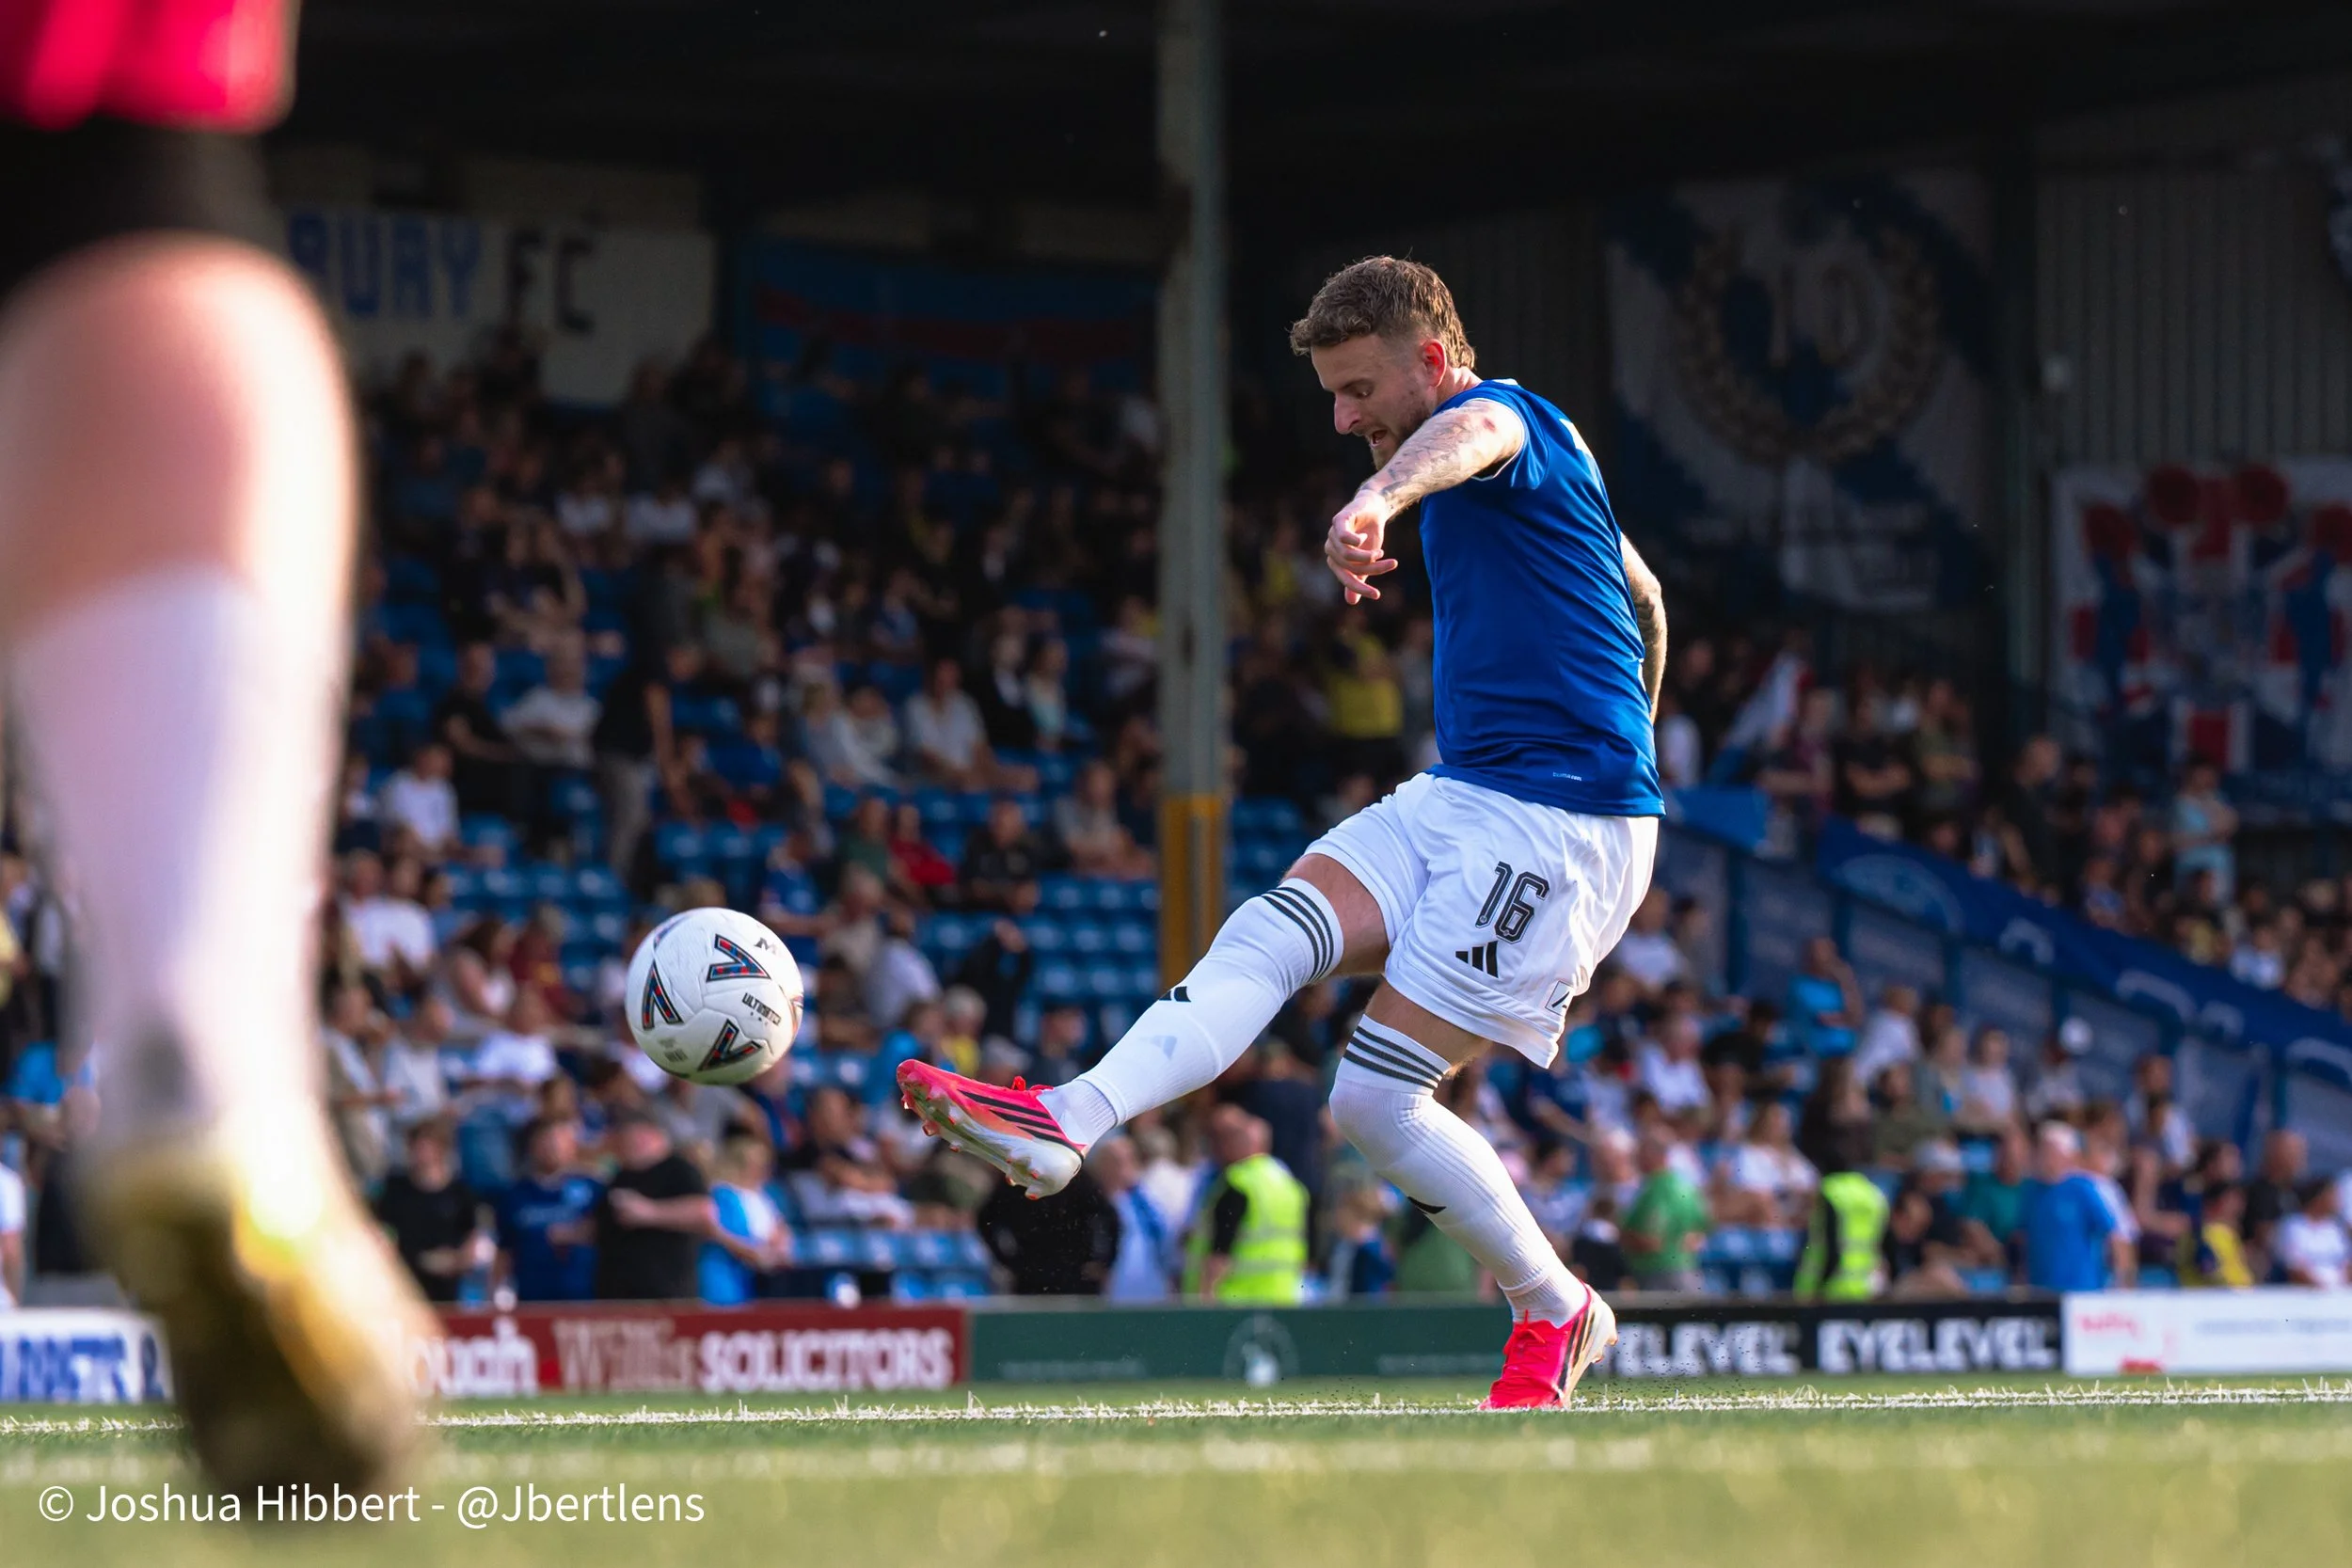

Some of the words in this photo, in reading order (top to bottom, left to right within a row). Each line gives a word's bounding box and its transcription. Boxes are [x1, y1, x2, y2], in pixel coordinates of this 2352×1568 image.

[506, 229, 598, 335] FC
[1475, 861, 1549, 943] 16
[699, 1328, 953, 1394] SOLICITORS
[1816, 1315, 2059, 1374] EYELEVEL
